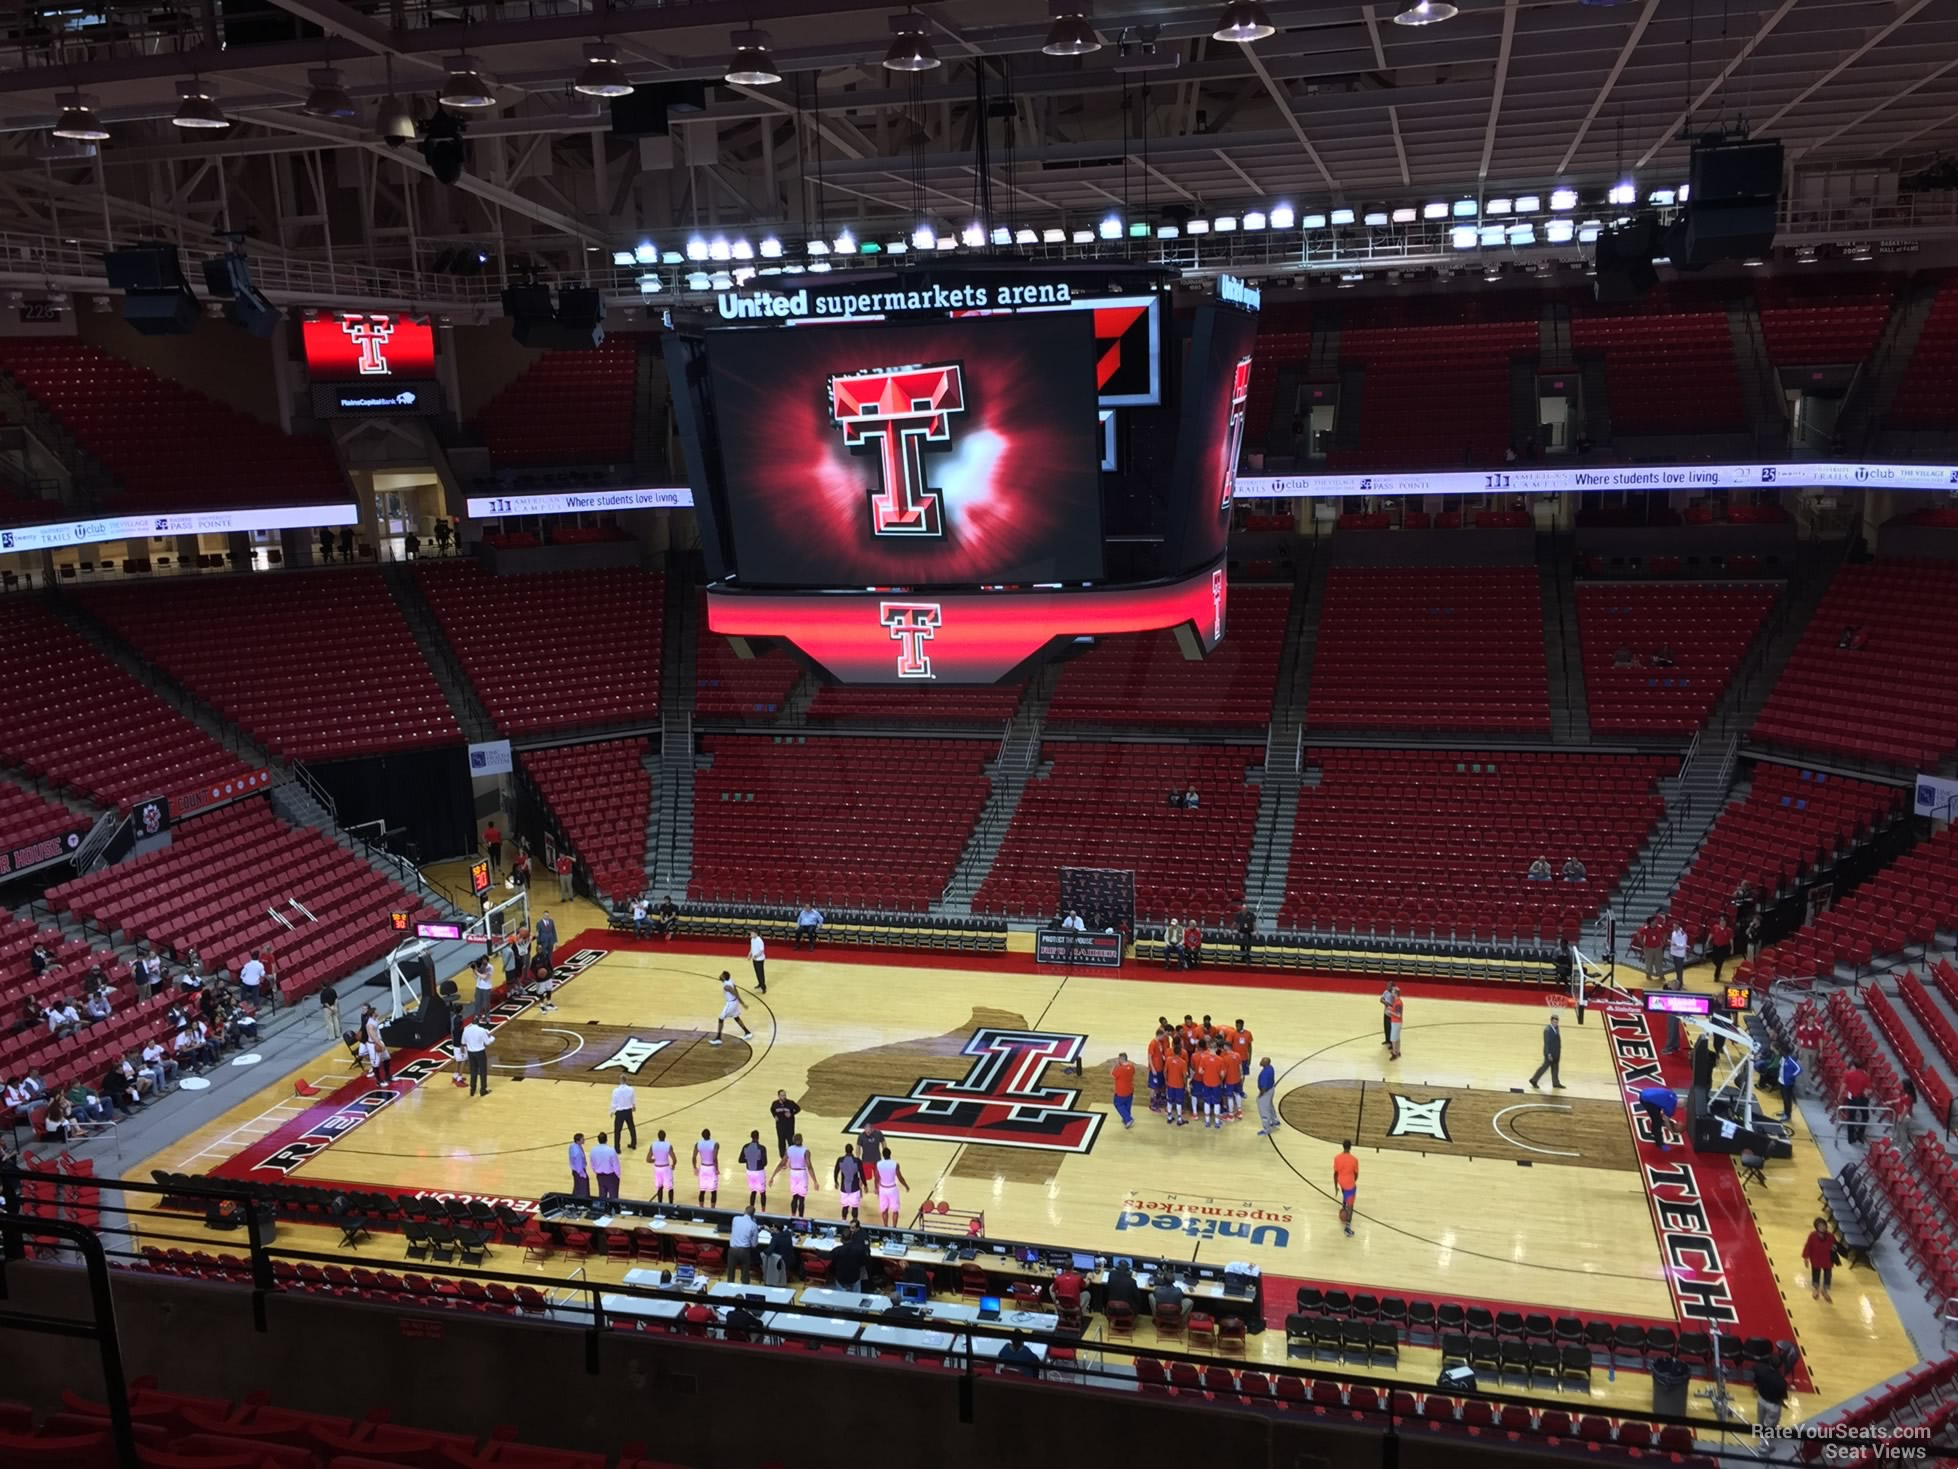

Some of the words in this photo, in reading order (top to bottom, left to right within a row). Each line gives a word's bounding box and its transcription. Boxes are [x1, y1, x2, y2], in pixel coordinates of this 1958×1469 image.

[718, 290, 808, 319] United
[815, 283, 987, 316] supermarkets
[997, 283, 1072, 305] arena
[1575, 473, 1609, 486] Where
[1613, 471, 1659, 485] students
[1662, 471, 1685, 483] love
[1688, 470, 1720, 484] living.
[1813, 473, 1849, 481] TRAILS
[566, 496, 595, 508] Where
[598, 494, 633, 506] students
[635, 493, 653, 504] love
[170, 521, 193, 530] PASS
[198, 520, 232, 529] POINTE
[41, 532, 71, 543] TRAILS
[178, 789, 209, 811] COUNT
[13, 837, 63, 869] HOUSE
[475, 872, 488, 889] 30
[395, 920, 406, 929] 30
[1731, 998, 1745, 1008] 30
[250, 1089, 400, 1175] RED
[1123, 1199, 1293, 1223] supermarkets
[1115, 1211, 1290, 1247] United
[1645, 1162, 1739, 1324] TECH
